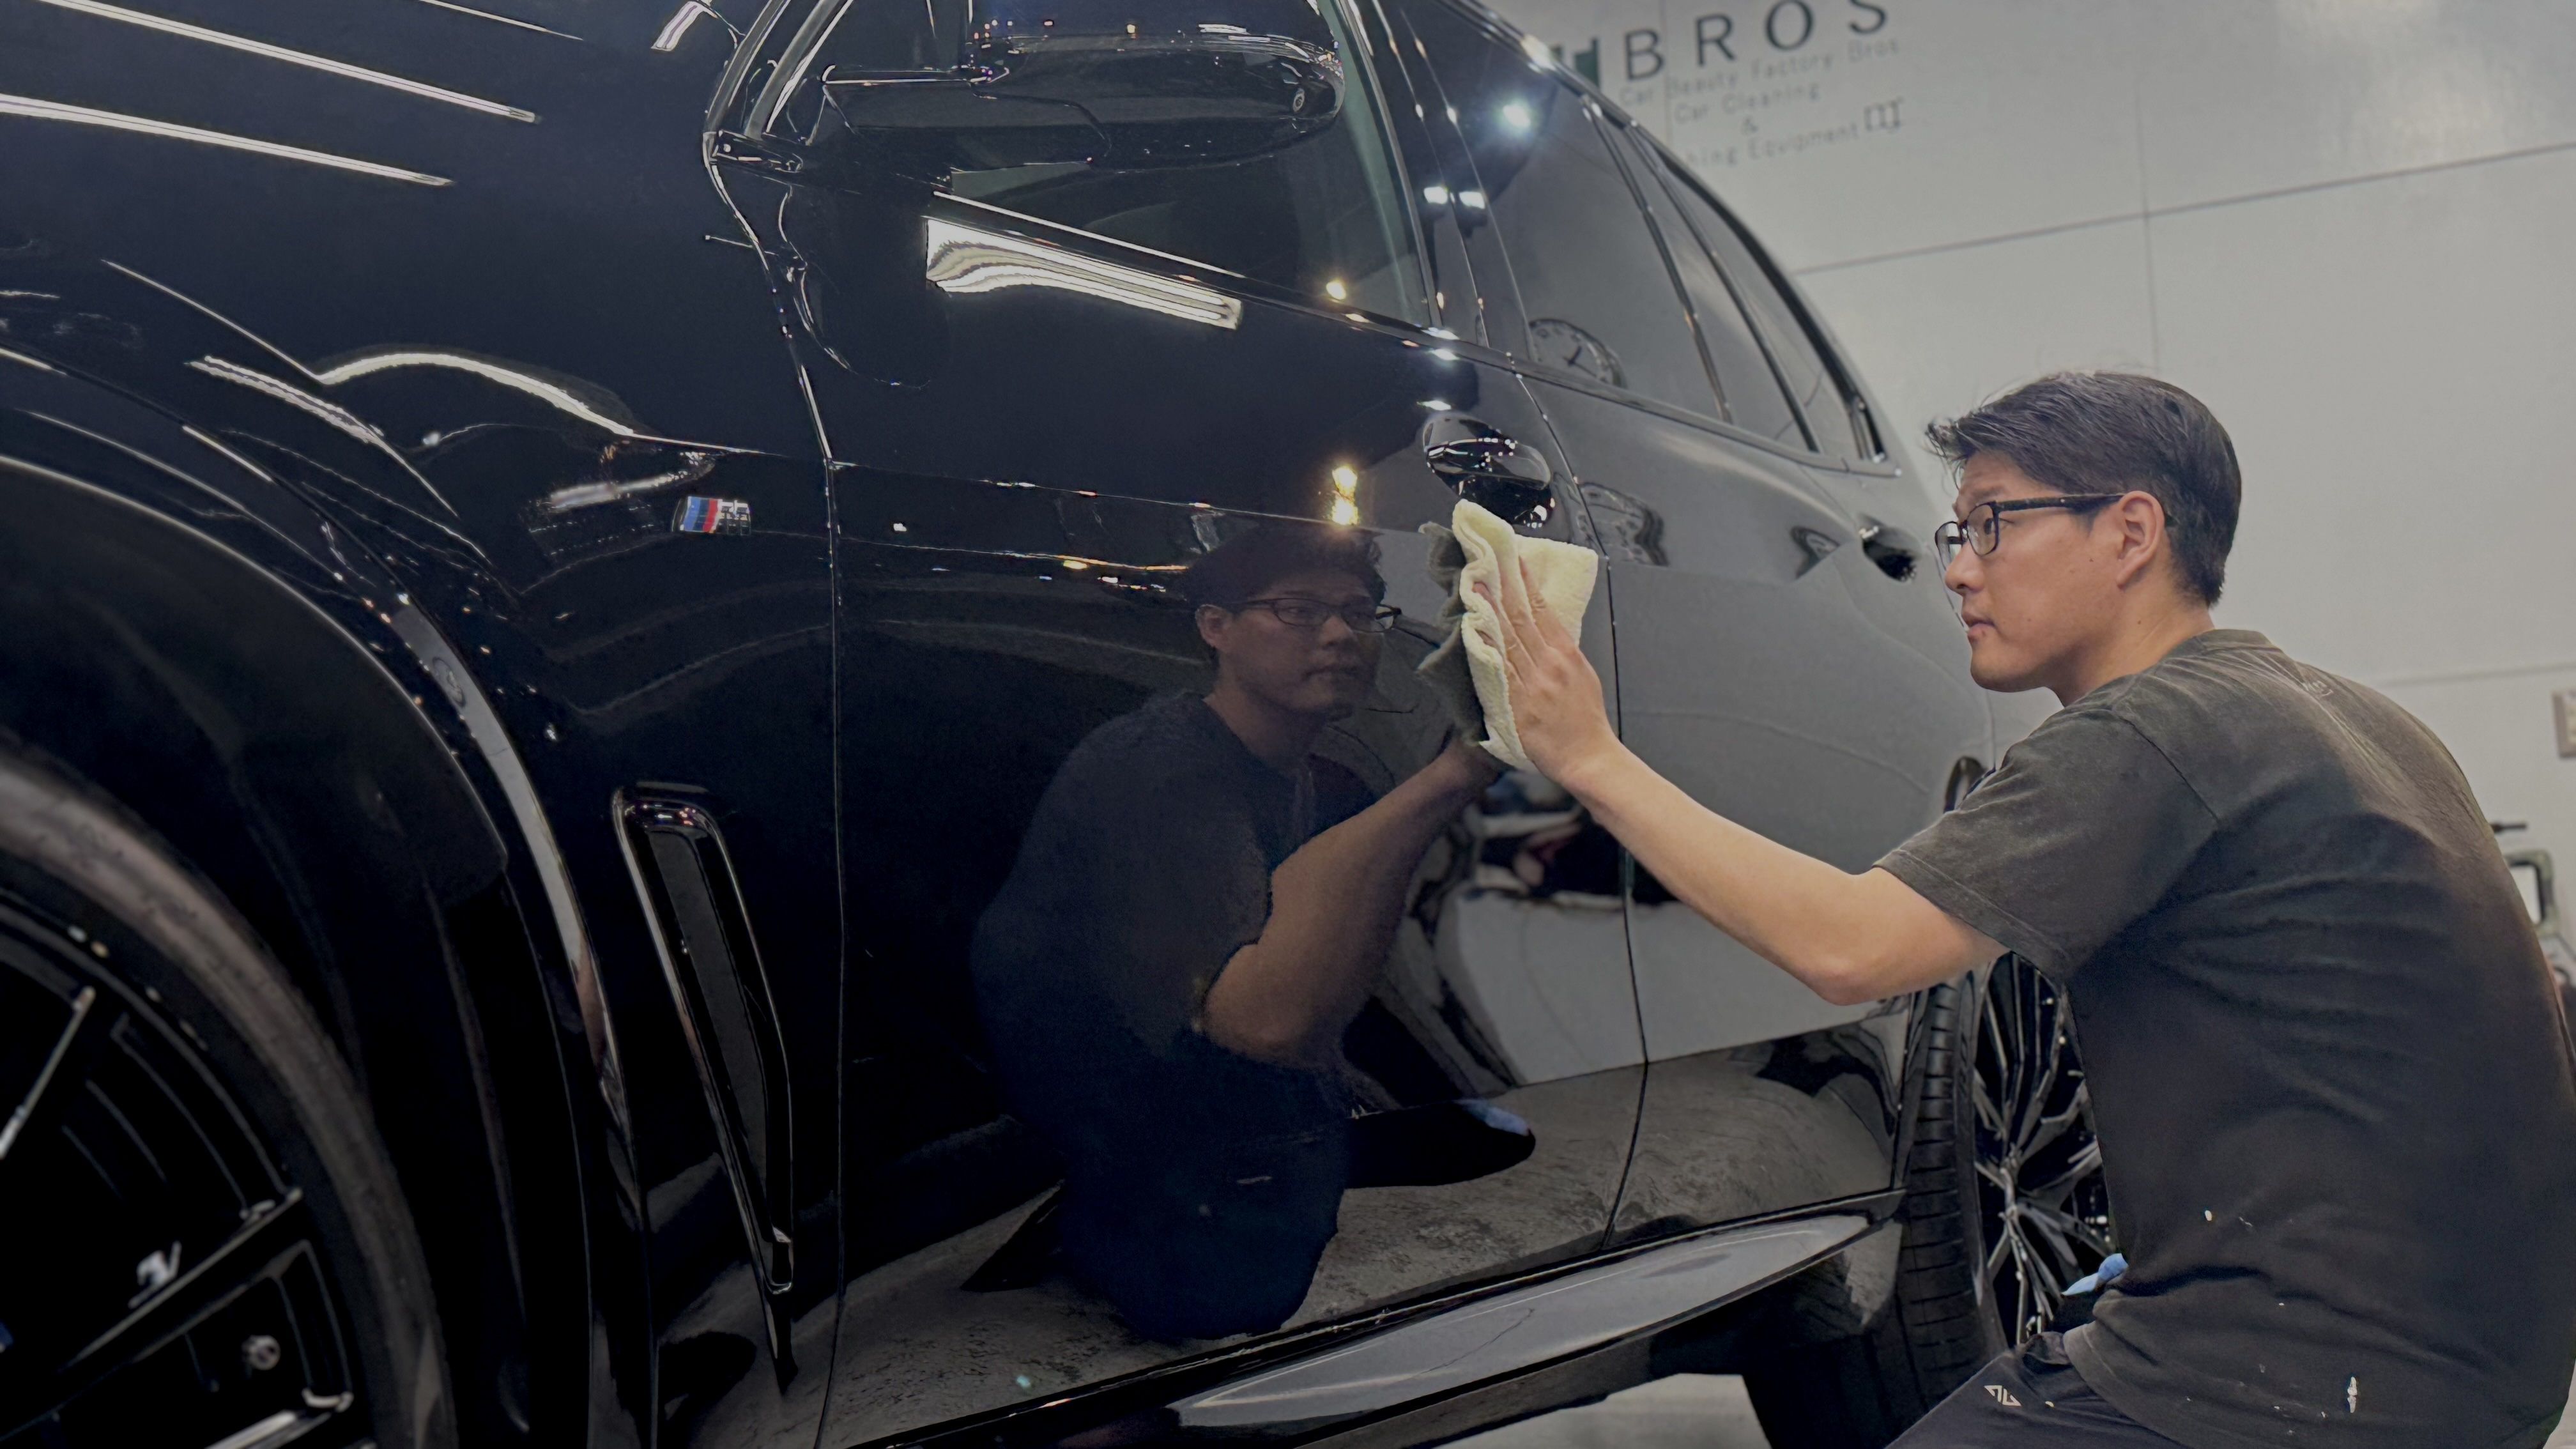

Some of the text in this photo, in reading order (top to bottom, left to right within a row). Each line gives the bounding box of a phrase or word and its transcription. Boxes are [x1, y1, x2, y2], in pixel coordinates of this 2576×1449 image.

[1625, 0, 1887, 81] BROS
[1619, 38, 1899, 107] Car Beauty Factory Bros
[1674, 82, 1820, 124] Car Cleaning
[1741, 115, 1758, 135] &
[1747, 121, 1858, 160] Equipment
